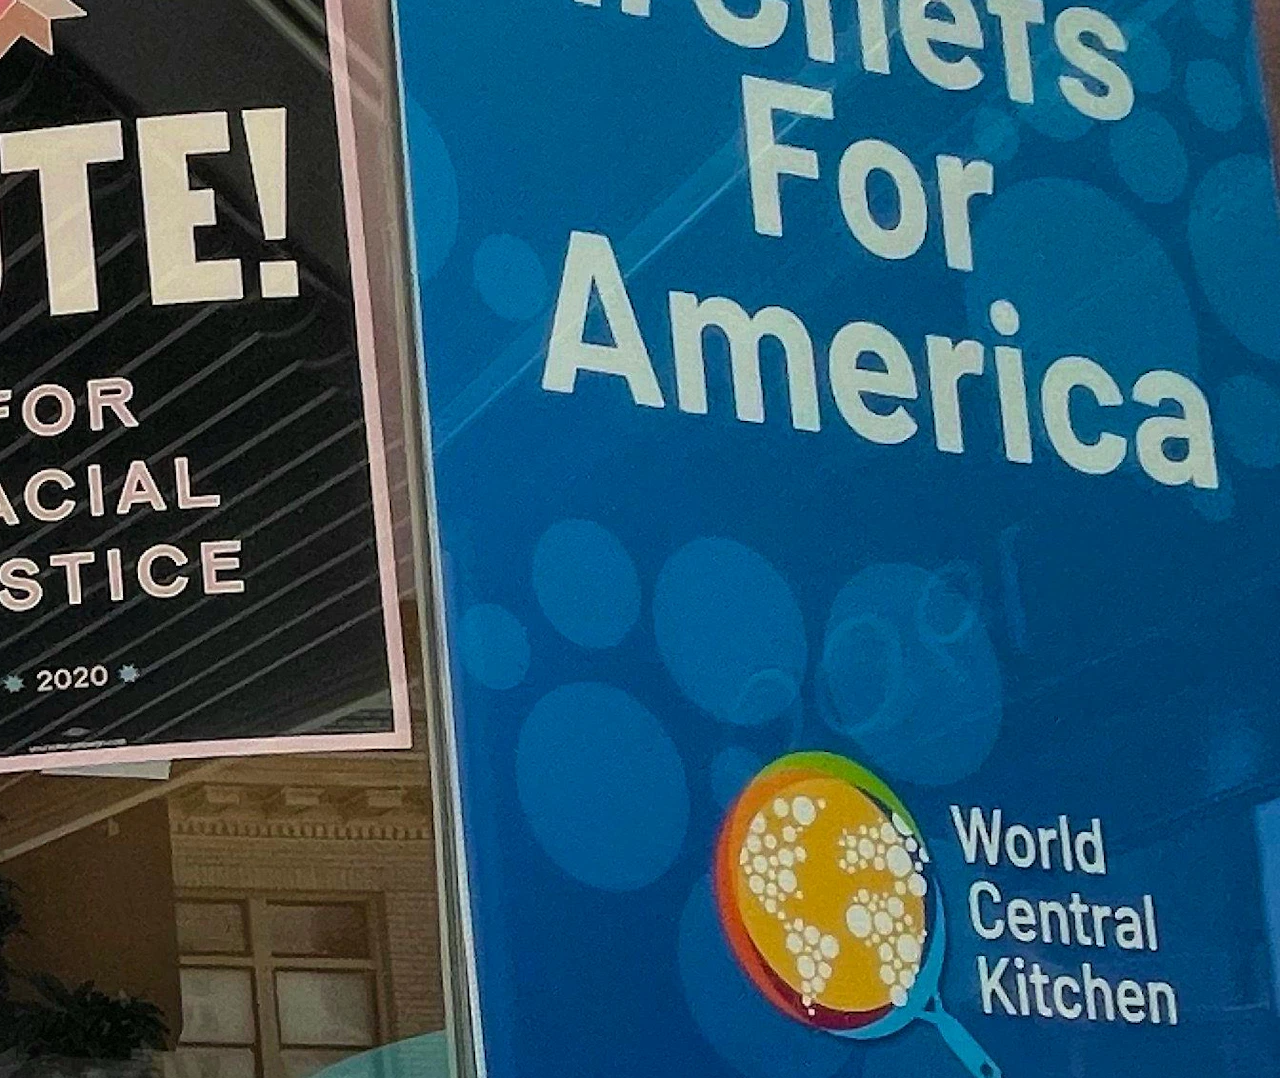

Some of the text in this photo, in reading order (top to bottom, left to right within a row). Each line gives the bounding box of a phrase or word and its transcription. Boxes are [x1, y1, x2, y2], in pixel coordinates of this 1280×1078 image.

[742, 74, 994, 272] For
[541, 230, 1220, 489] America
[36, 665, 108, 692] 2020
[949, 804, 1107, 875] World
[967, 880, 1158, 952] Central
[977, 955, 1179, 1025] Kitchen
